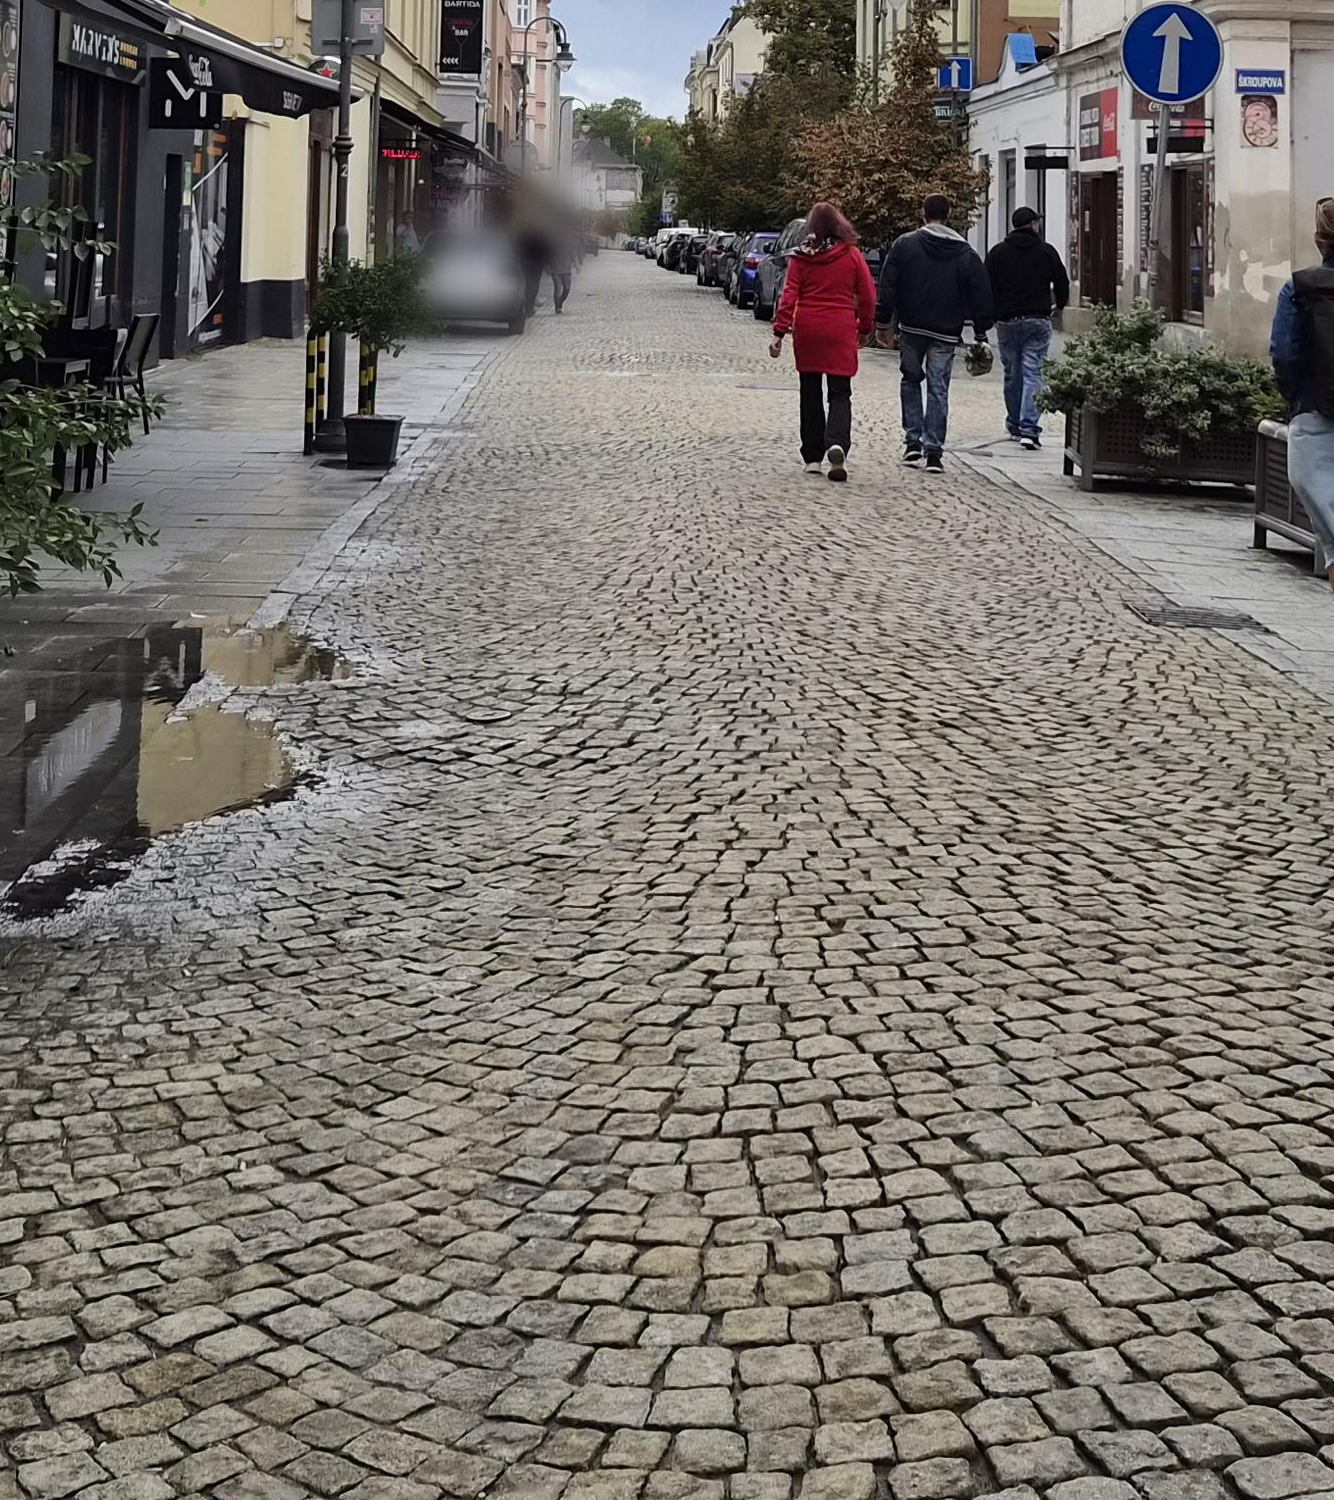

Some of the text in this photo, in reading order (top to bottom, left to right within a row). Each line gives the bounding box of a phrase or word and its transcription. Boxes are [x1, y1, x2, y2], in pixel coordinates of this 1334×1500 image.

[444, 0, 481, 8] BARTIDA
[1237, 73, 1283, 88] ŠKROUPOVA
[340, 163, 349, 178] 2
